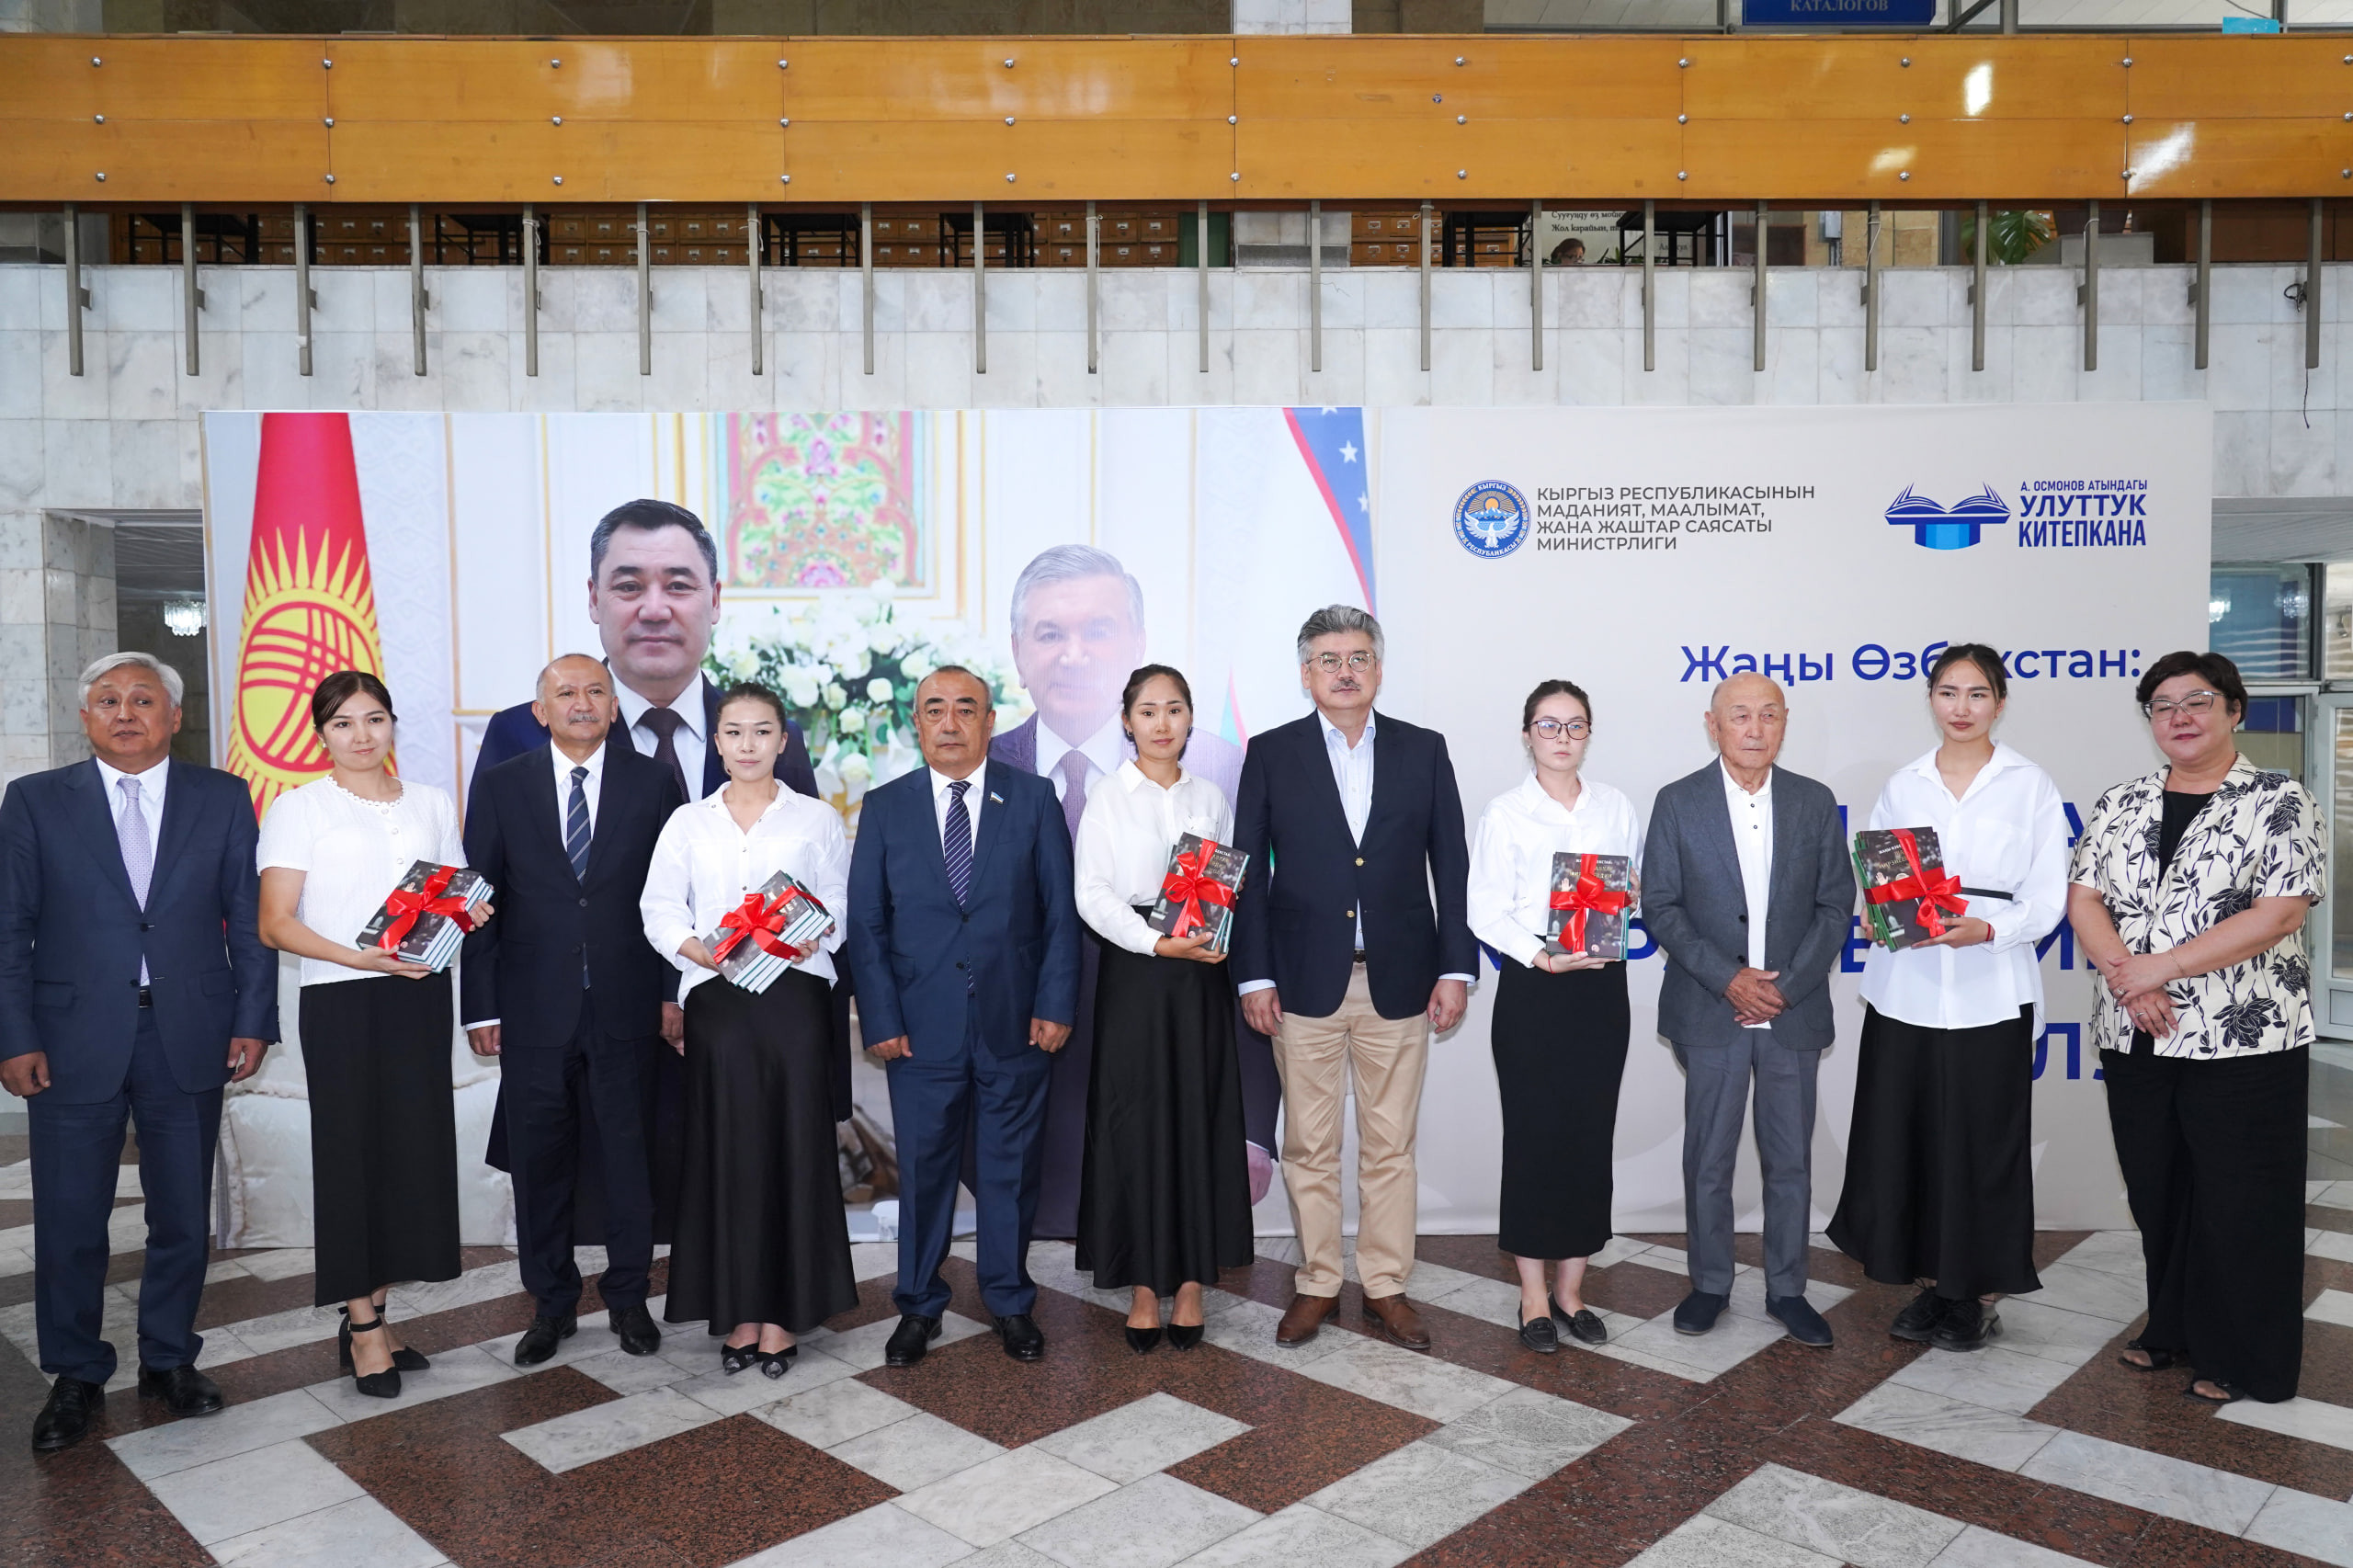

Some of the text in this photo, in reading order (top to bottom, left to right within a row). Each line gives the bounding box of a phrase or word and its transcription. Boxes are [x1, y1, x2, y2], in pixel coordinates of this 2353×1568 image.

[1790, 0, 1890, 12] КАТАЛОГОВ
[1478, 483, 1507, 491] КЫРГЫЗ
[1537, 486, 1815, 501] КЫРГЫЗ РЕСПУБЛИКАСЫНЫН
[2020, 479, 2148, 493] А. ОСМОНОВ АТЫНДАГЫ
[1537, 503, 1765, 519] МАДАНИЯТ, МААЛЫМАТ,
[2020, 494, 2146, 517] УЛУТТУК
[1537, 519, 1773, 534] ЖАНА ЖАШТАР САЯСАТЫ
[2018, 519, 2146, 548] КИТЕПКАНА
[1537, 537, 1677, 551] МИНИСТРЛИГИ
[1679, 641, 2141, 687] Жаңы Өзбстан:
